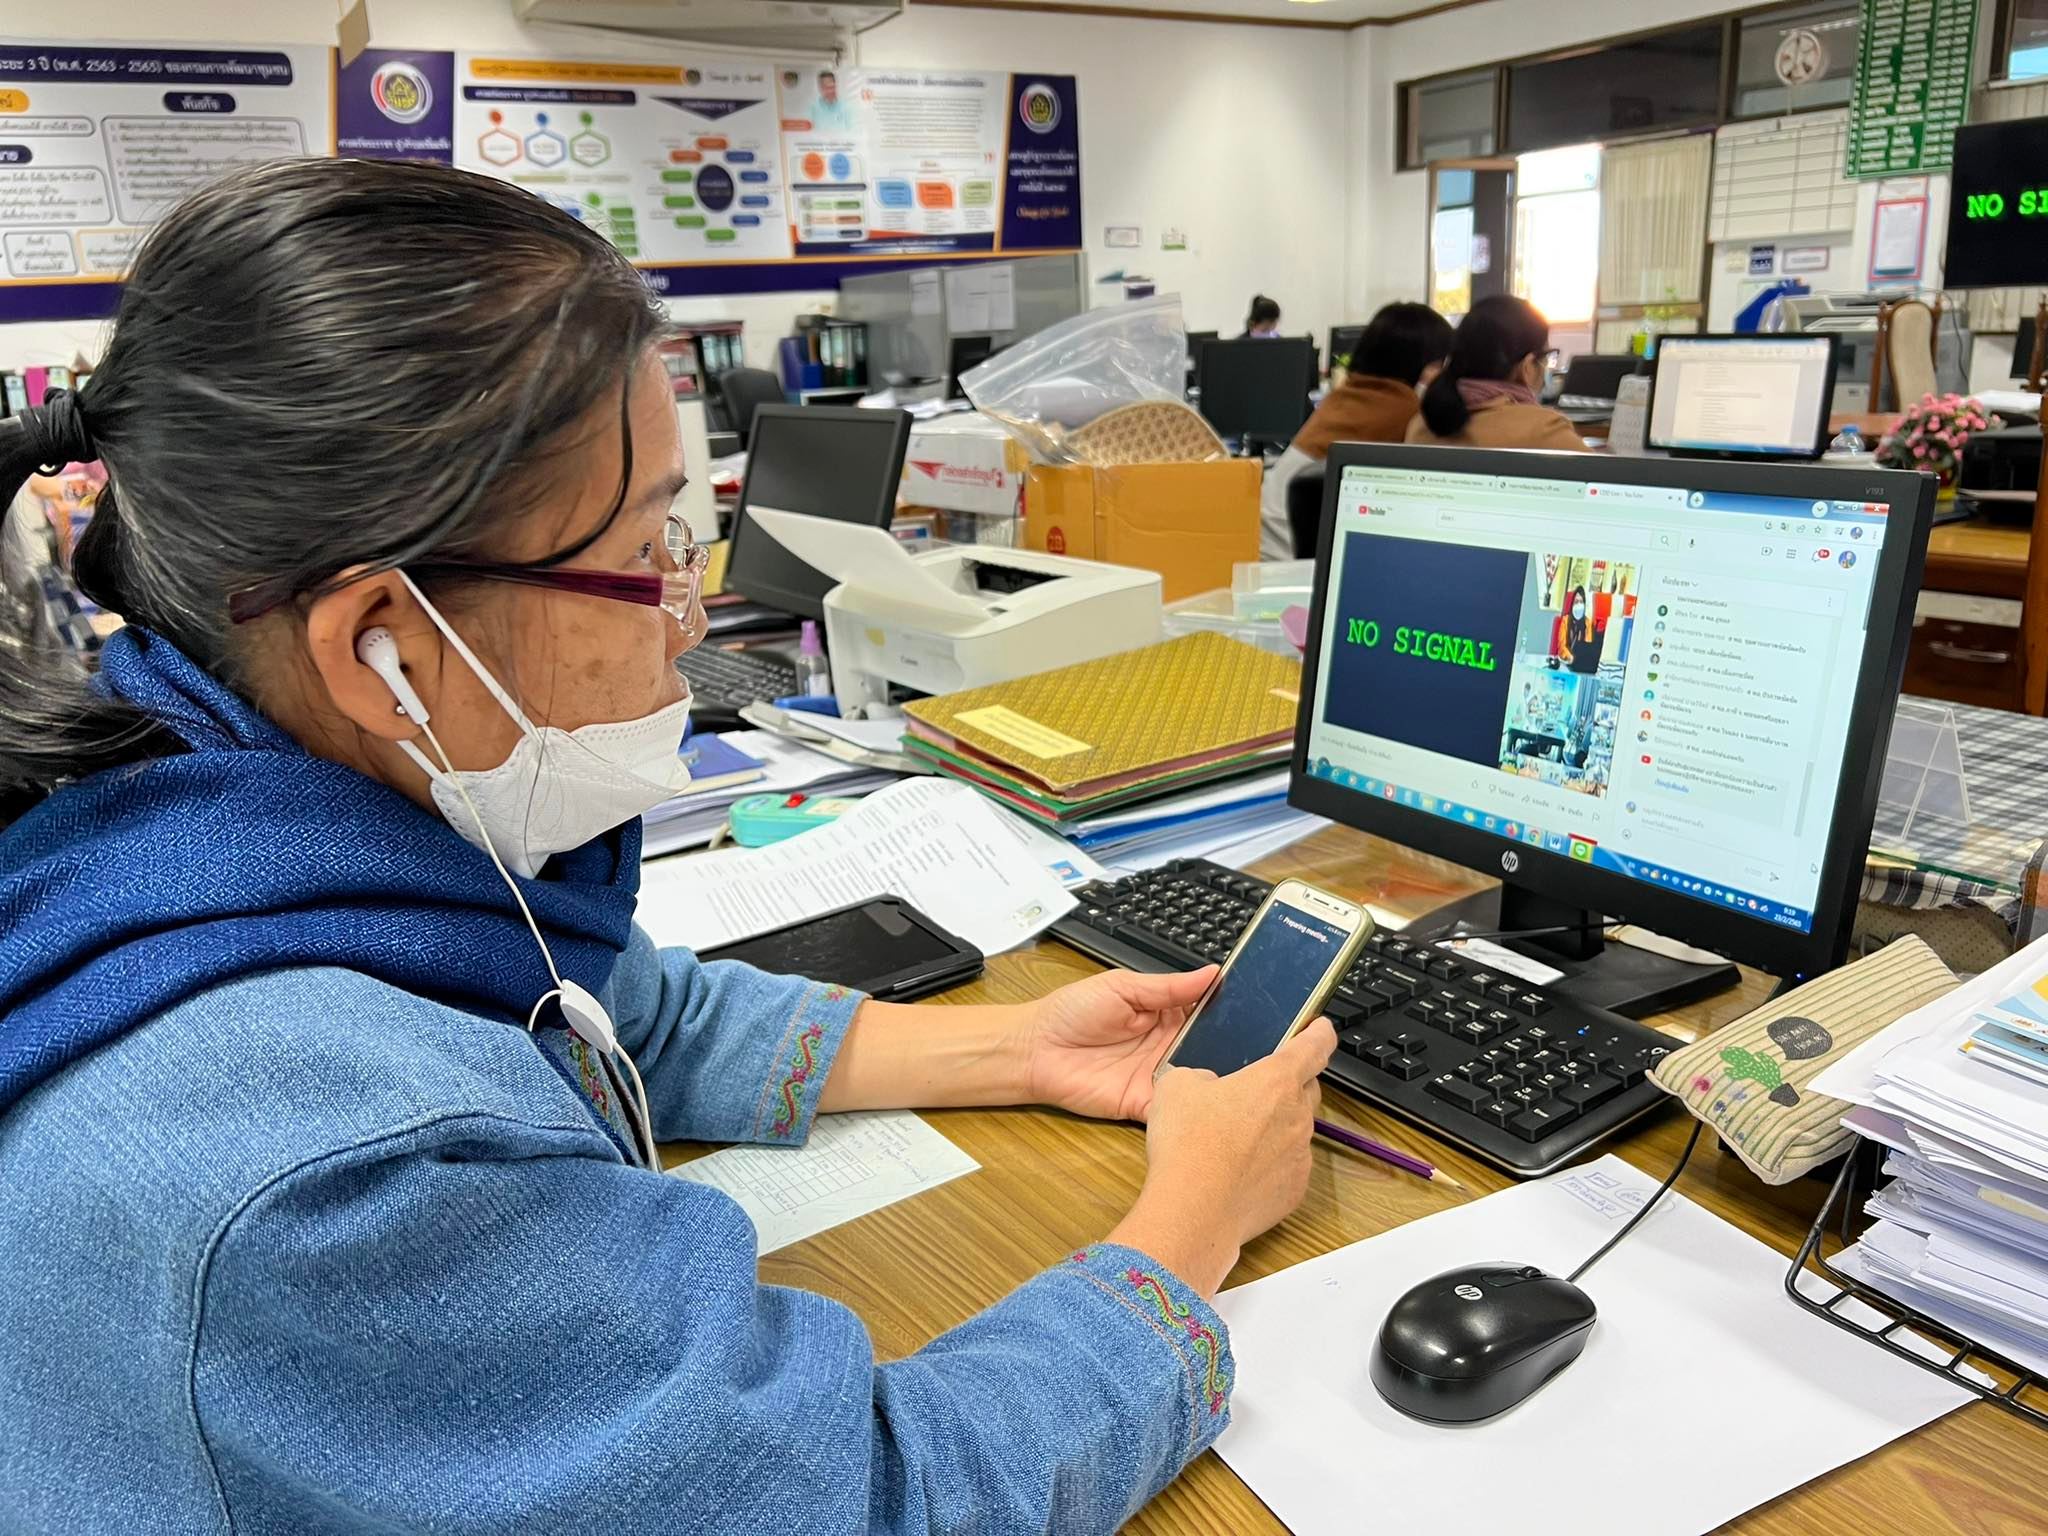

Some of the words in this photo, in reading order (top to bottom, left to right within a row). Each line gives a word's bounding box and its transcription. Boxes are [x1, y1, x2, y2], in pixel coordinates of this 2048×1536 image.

[27, 58, 36, 71] 3
[1966, 193, 2003, 218] NO
[1864, 487, 1885, 496] V193
[1347, 618, 1378, 647] NO
[1394, 626, 1496, 671] SIGNAL
[1502, 850, 1518, 872] hp
[1455, 1285, 1482, 1300] hp
